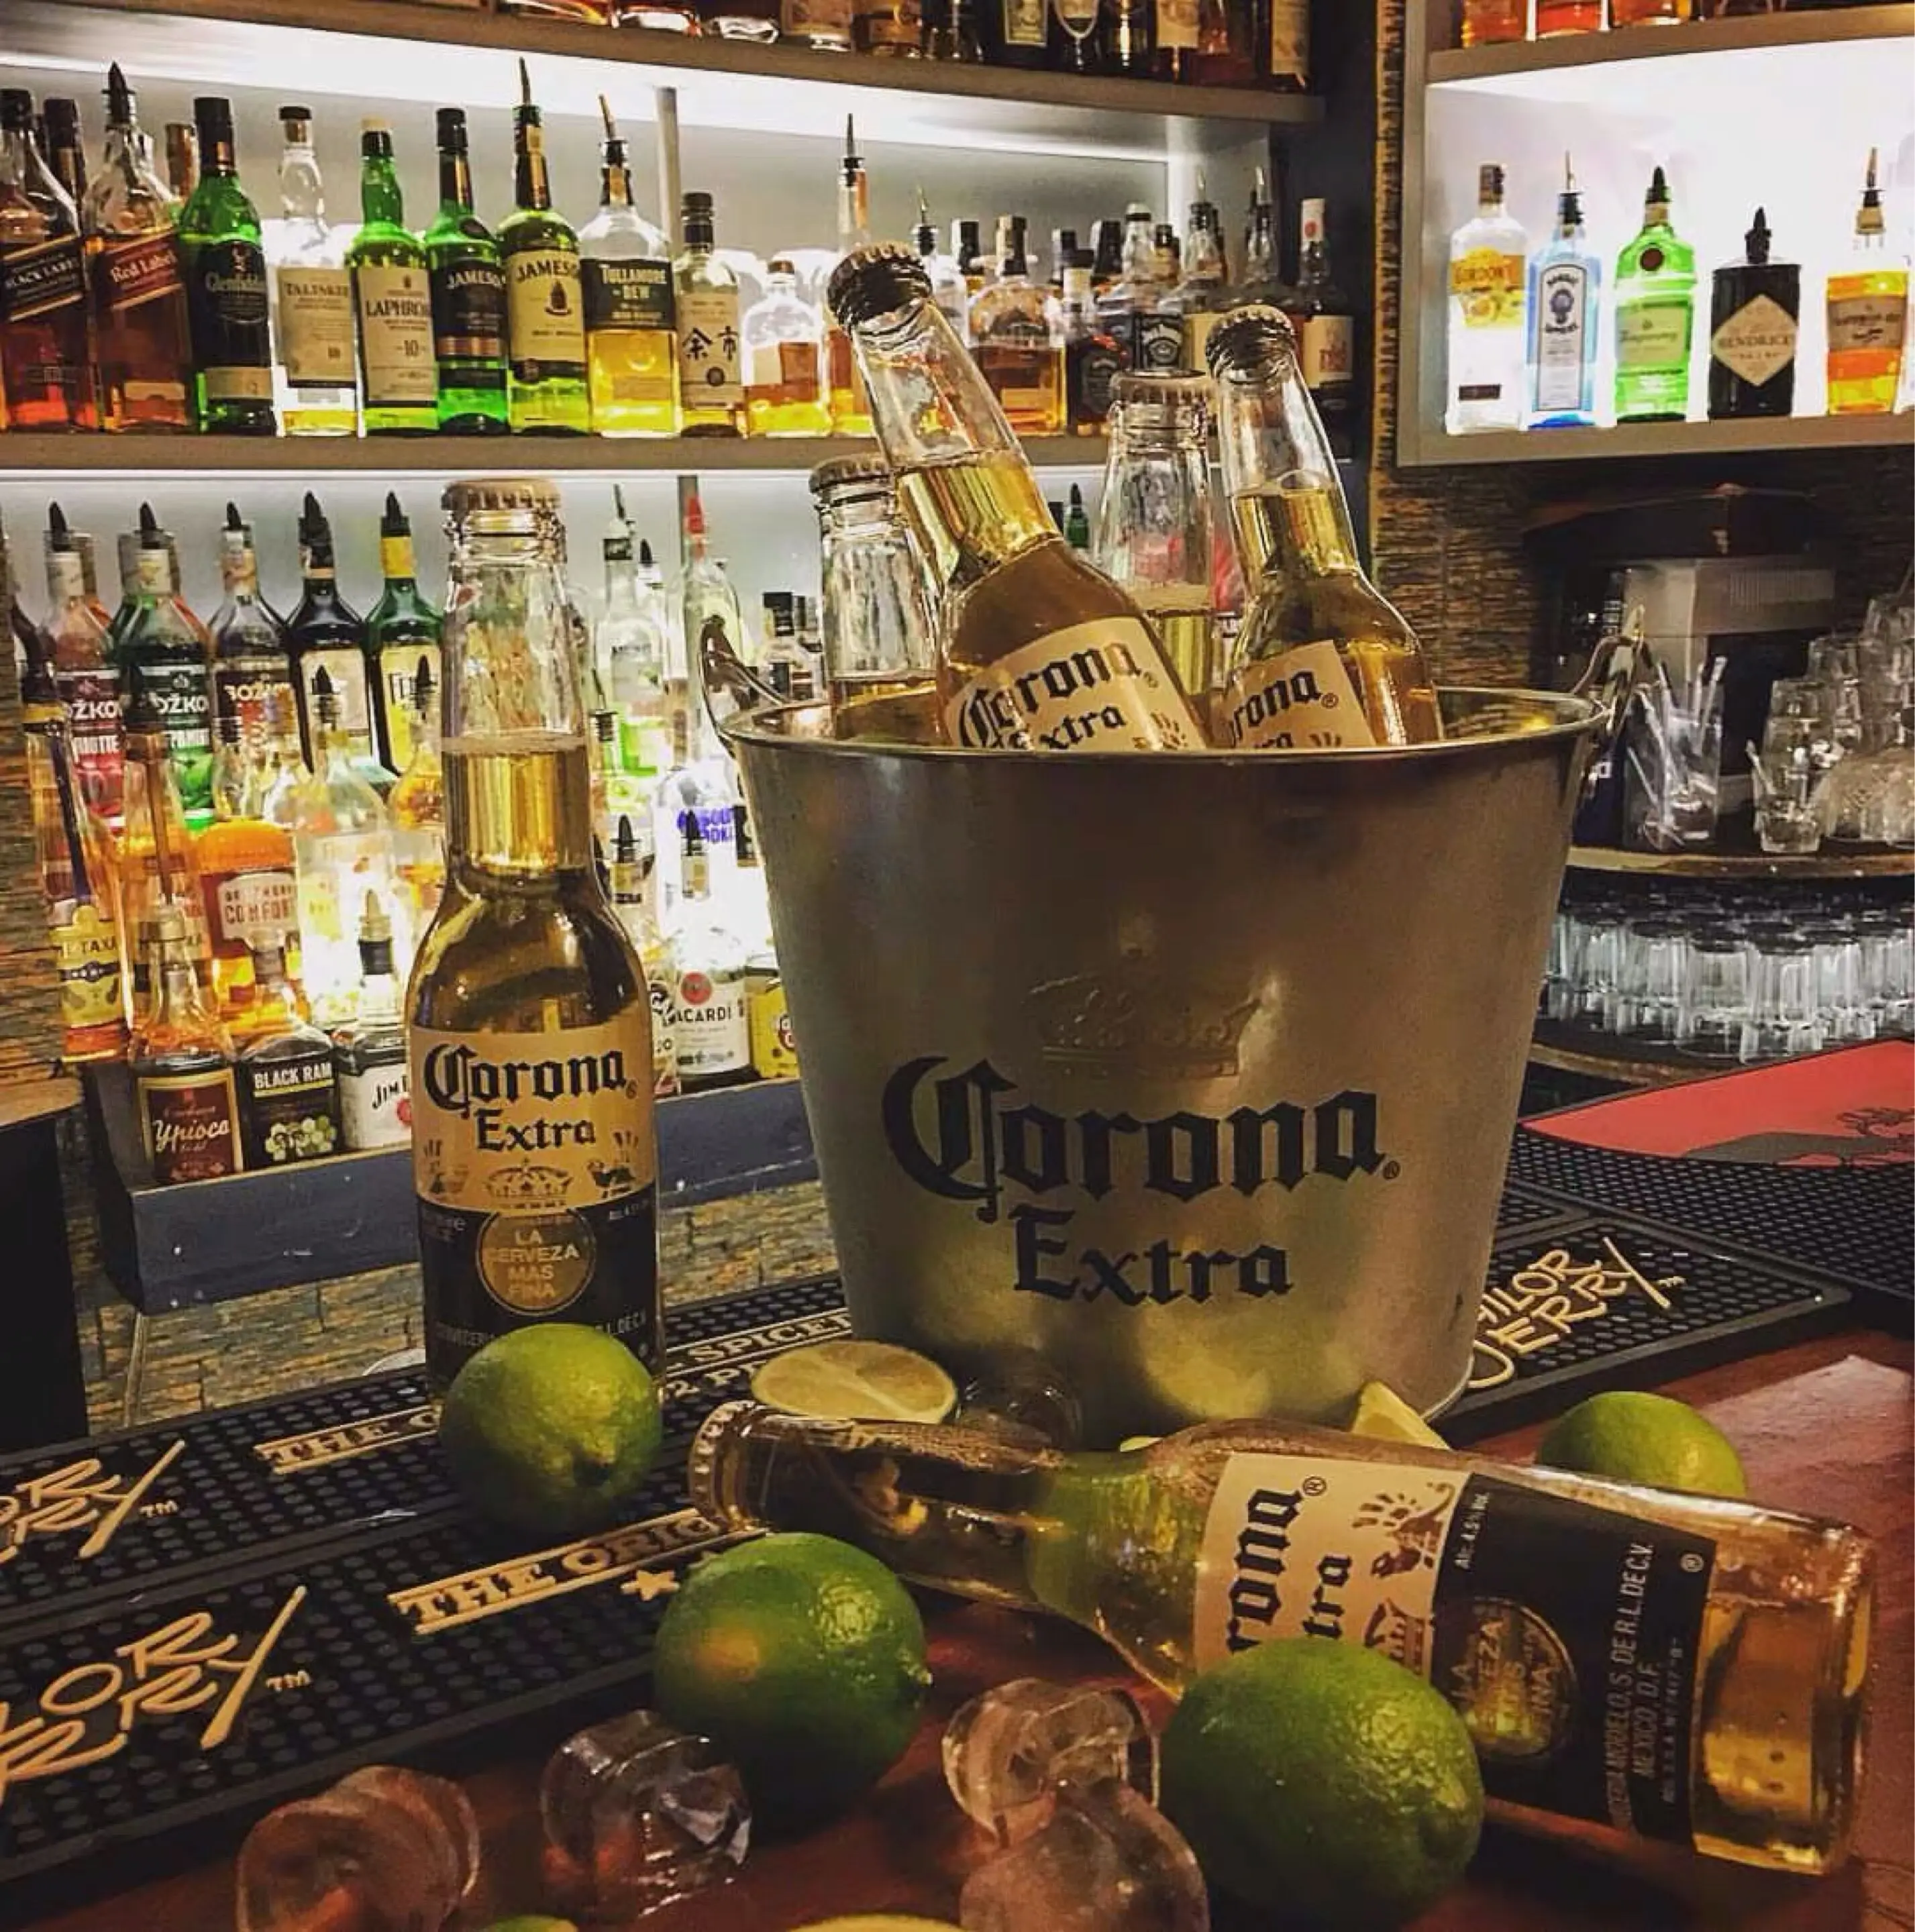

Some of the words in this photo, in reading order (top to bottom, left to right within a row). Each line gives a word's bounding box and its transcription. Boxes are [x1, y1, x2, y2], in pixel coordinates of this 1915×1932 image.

[515, 258, 578, 282] JAMES
[403, 337, 419, 357] 10
[959, 643, 1142, 748] Corona
[254, 1068, 299, 1089] BLACK
[303, 1063, 333, 1083] RAM
[425, 1043, 627, 1119] Corona
[474, 1108, 597, 1152] Extra
[882, 1056, 1386, 1224] Corona
[515, 1228, 542, 1245] LA
[1008, 1203, 1294, 1307] Extra
[269, 1421, 403, 1465] THE
[402, 1562, 556, 1623] THE
